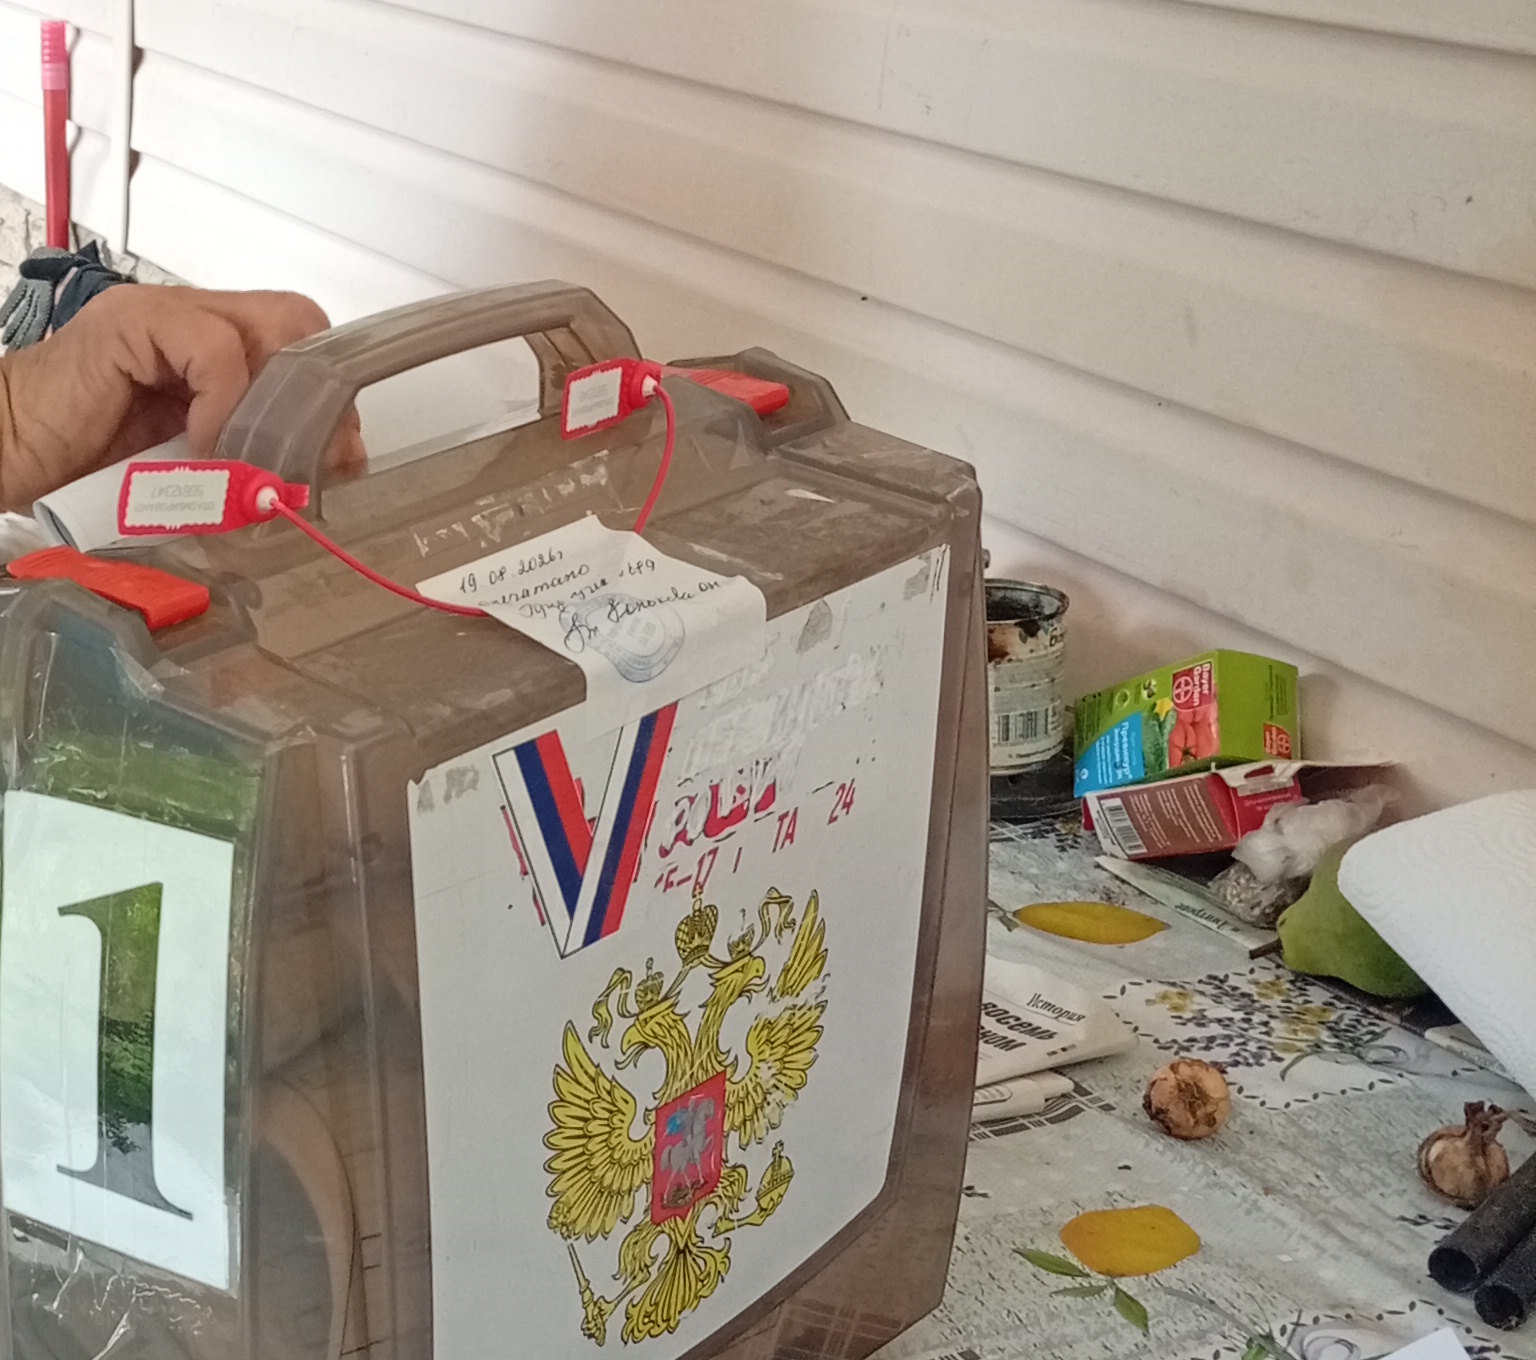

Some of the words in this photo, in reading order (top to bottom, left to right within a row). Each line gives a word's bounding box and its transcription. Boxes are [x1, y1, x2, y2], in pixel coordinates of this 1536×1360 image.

[1192, 665, 1202, 707] Garden
[1201, 663, 1211, 696] Bayer
[1025, 991, 1087, 1024] История
[56, 880, 194, 1221] 1
